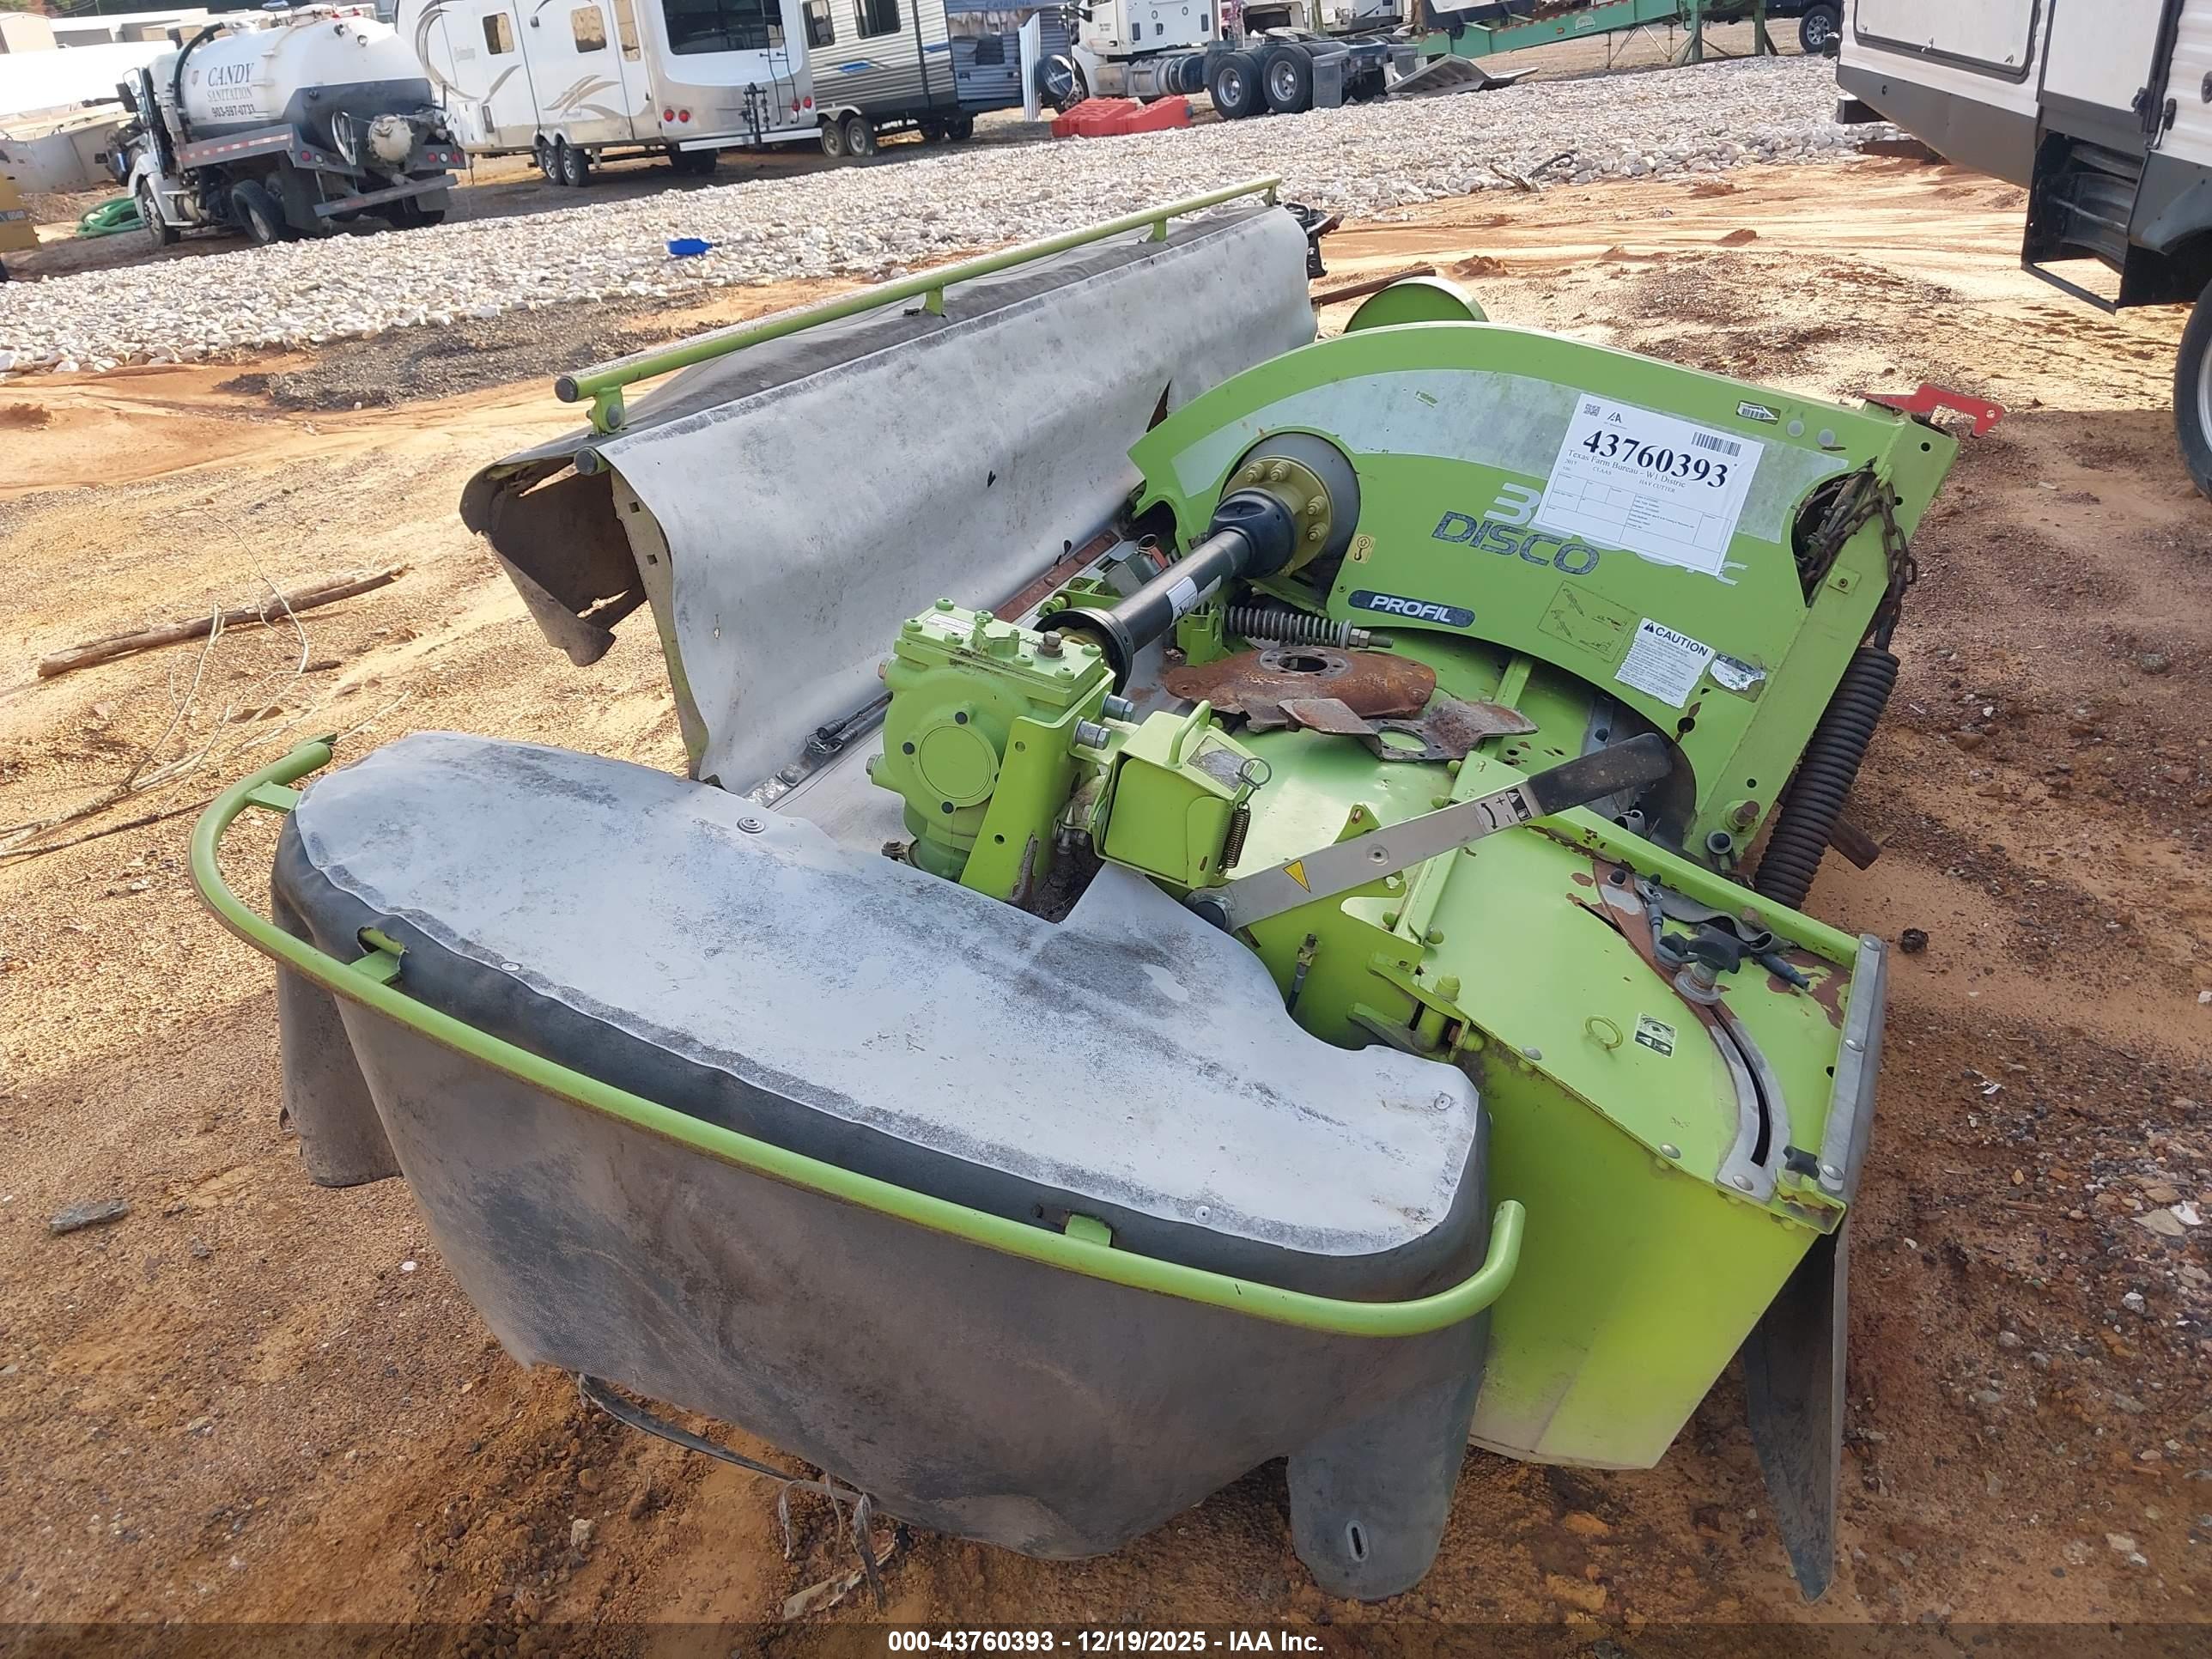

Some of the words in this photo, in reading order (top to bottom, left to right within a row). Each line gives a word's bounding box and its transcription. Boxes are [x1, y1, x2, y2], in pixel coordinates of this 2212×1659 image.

[208, 63, 255, 87] CANDY
[207, 87, 253, 102] SANITATION
[1568, 449, 1589, 462] Texas
[1590, 455, 1611, 467] Farm
[1612, 460, 1638, 475] Bureau
[1661, 475, 1686, 488] Distric
[1583, 430, 1729, 489] 43760393
[1431, 511, 1601, 575] DISCO
[1370, 595, 1451, 623] PROFIL
[1655, 627, 1709, 657] CAUTION
